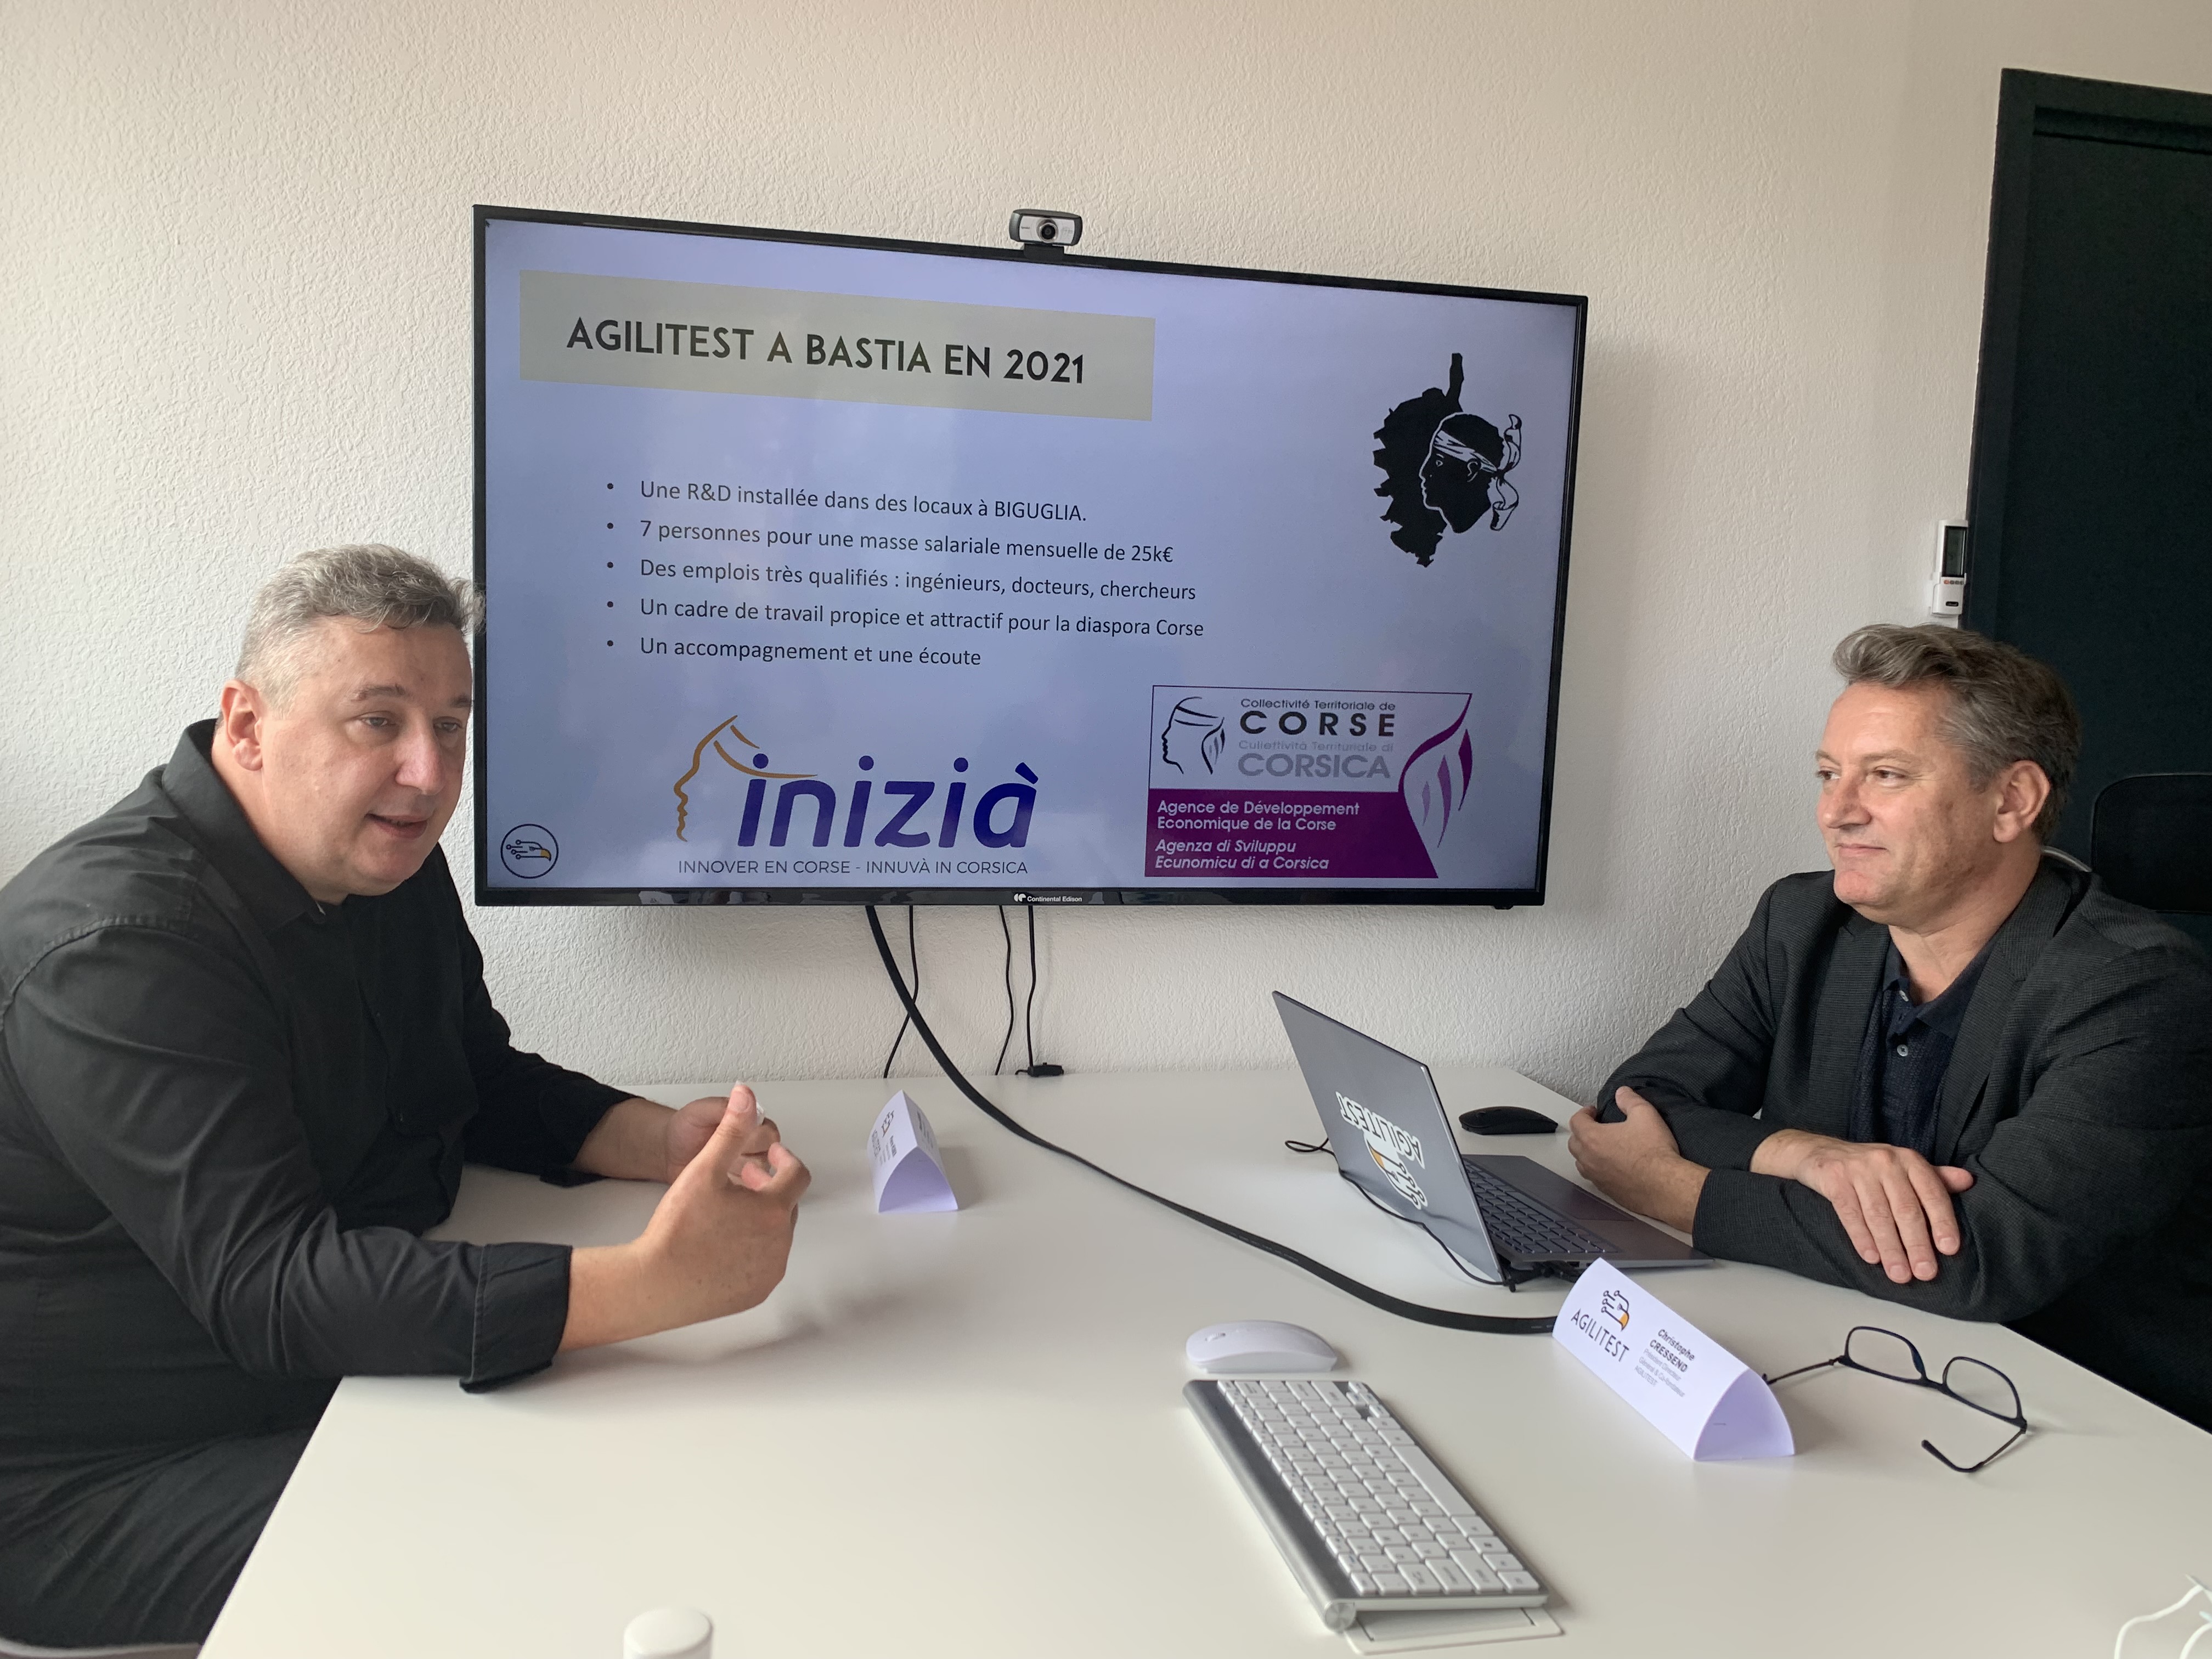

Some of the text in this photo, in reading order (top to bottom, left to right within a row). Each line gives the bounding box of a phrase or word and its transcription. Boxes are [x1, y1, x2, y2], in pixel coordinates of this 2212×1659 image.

[566, 317, 1083, 384] AGILITEST A BASTIA EN 2021
[641, 480, 1086, 521] Une R&D installée dans des locaux à BIGUGLIA.
[640, 520, 1173, 563] 7 personnes pour une masse salariale mensuelle de 25k€
[641, 559, 1196, 600] Des emplois très qualifiés : ingénieurs, docteurs, chercheurs
[641, 598, 1204, 637] Un cadre de travail propice et attractif pour la diaspora Corse
[641, 637, 981, 665] Un accompagnement et une écoute
[1240, 698, 1396, 711] Collectivité Territoriale de
[1240, 710, 1395, 737] CORSE
[1381, 742, 1394, 753] di
[1238, 753, 1391, 779] CORSICA
[737, 753, 1039, 848] inizià
[1157, 800, 1360, 817] Agence de Développement
[1158, 816, 1336, 832] Economique de la Corse
[1155, 839, 1296, 855] Agenza di Sviluppu
[679, 860, 759, 873] INNOVER
[765, 860, 787, 873] EN
[793, 860, 850, 873] CORSE
[866, 857, 930, 874] INNUVÀ
[935, 861, 951, 873] IN
[956, 861, 1028, 874] CORSICA
[1155, 855, 1329, 870] Ecunomicu di a Corsica
[1339, 1096, 1422, 1164] AGILITEST
[1570, 1308, 1629, 1362] AGILITEST
[1657, 1328, 1695, 1361] Christophe
[1649, 1339, 1688, 1373] CRESSEND
